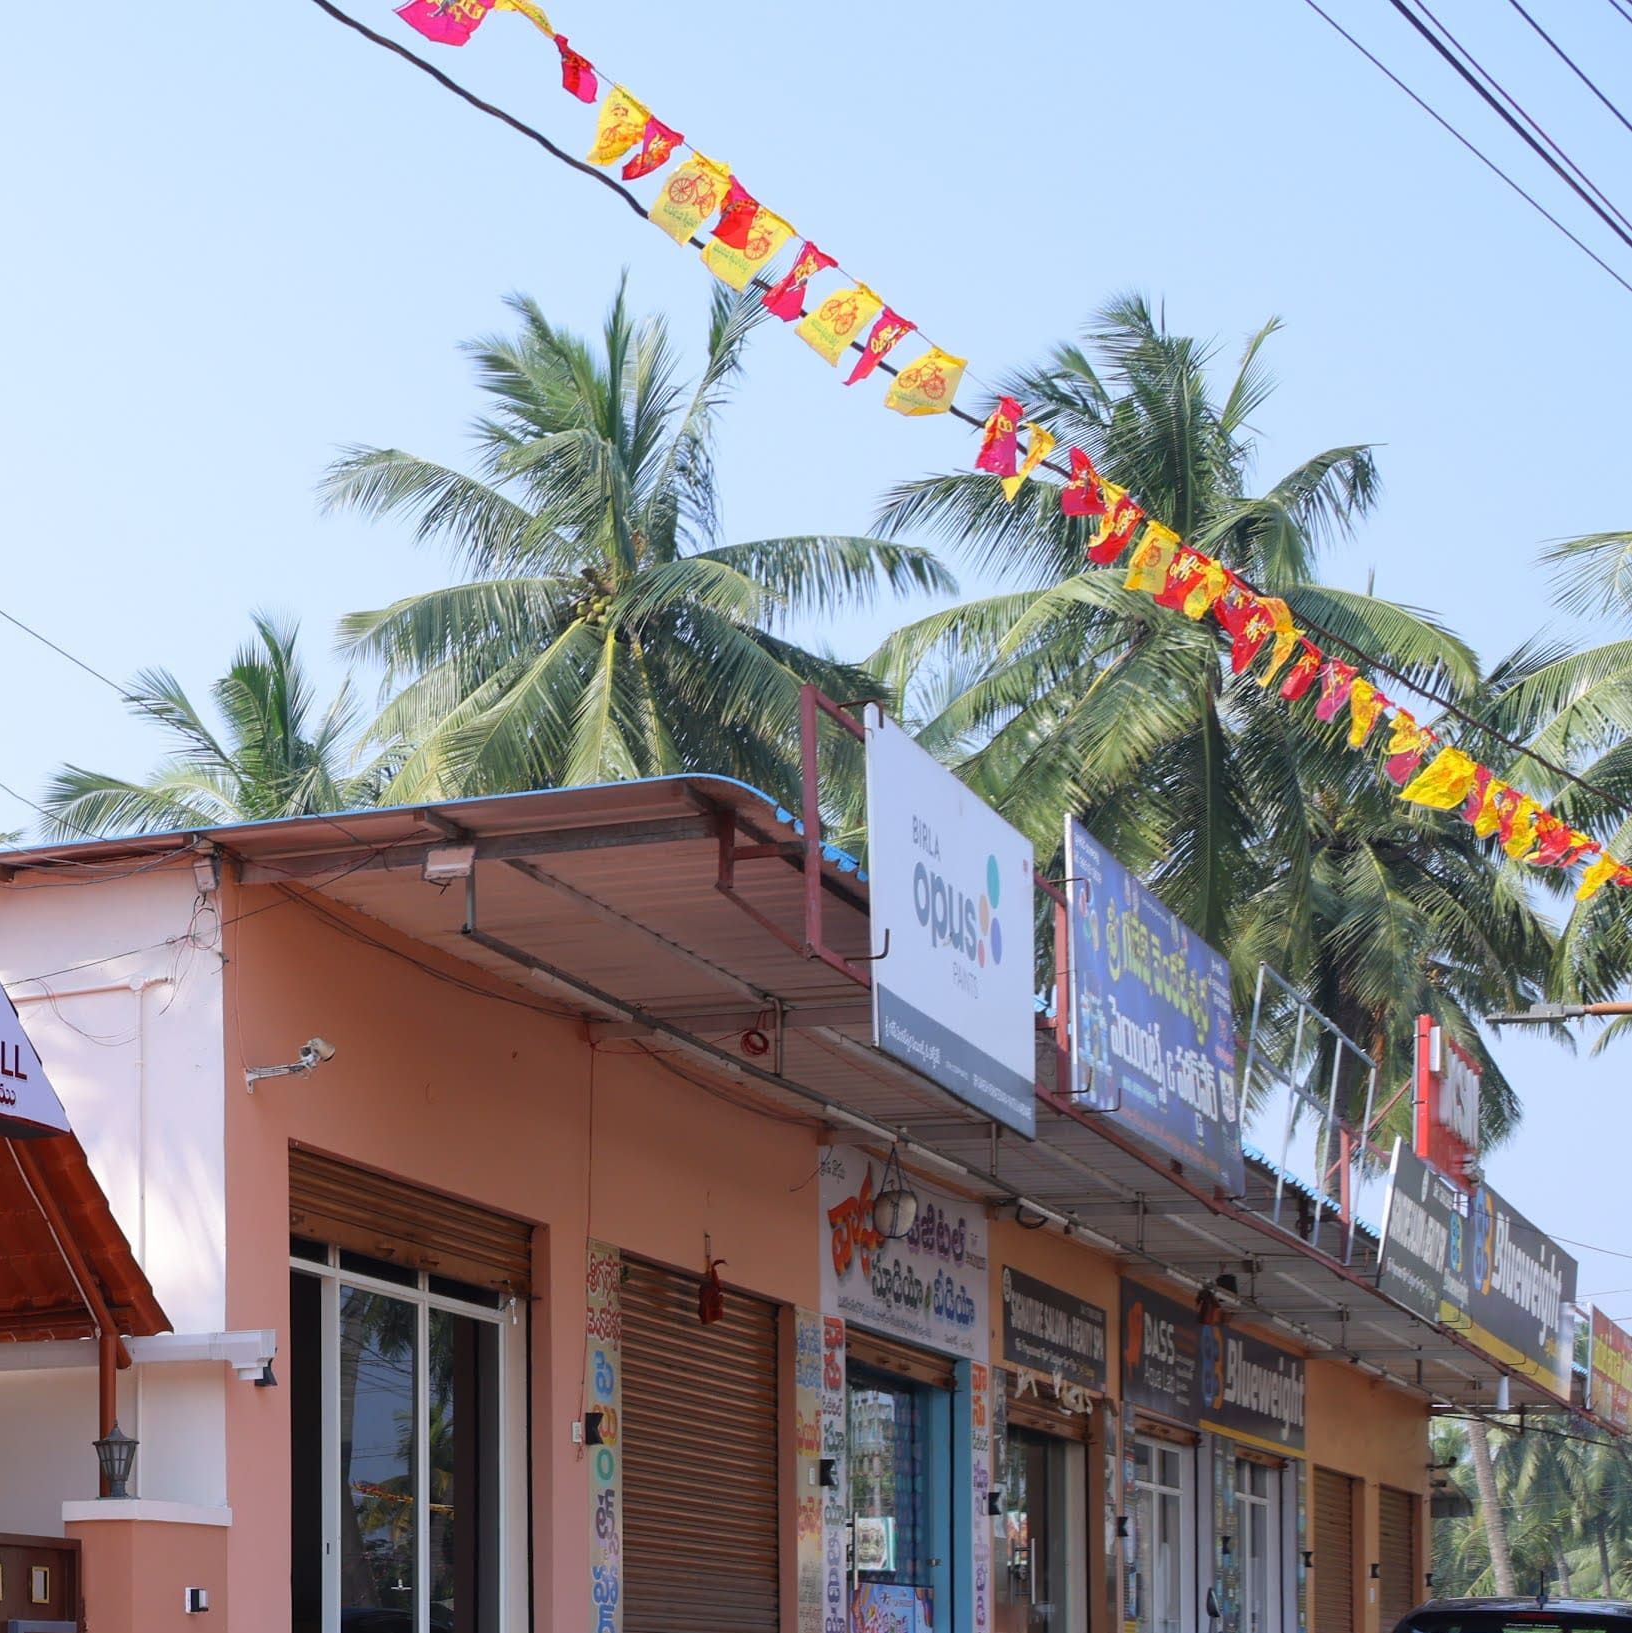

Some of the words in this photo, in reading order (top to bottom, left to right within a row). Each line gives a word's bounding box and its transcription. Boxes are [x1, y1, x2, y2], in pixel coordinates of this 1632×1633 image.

[911, 815, 940, 862] BIRLA
[913, 861, 977, 964] opus
[952, 962, 980, 1001] PAINTS
[1492, 1211, 1562, 1347] Blueweight
[1144, 1311, 1175, 1365] DASS
[1223, 1338, 1305, 1441] Blueweight
